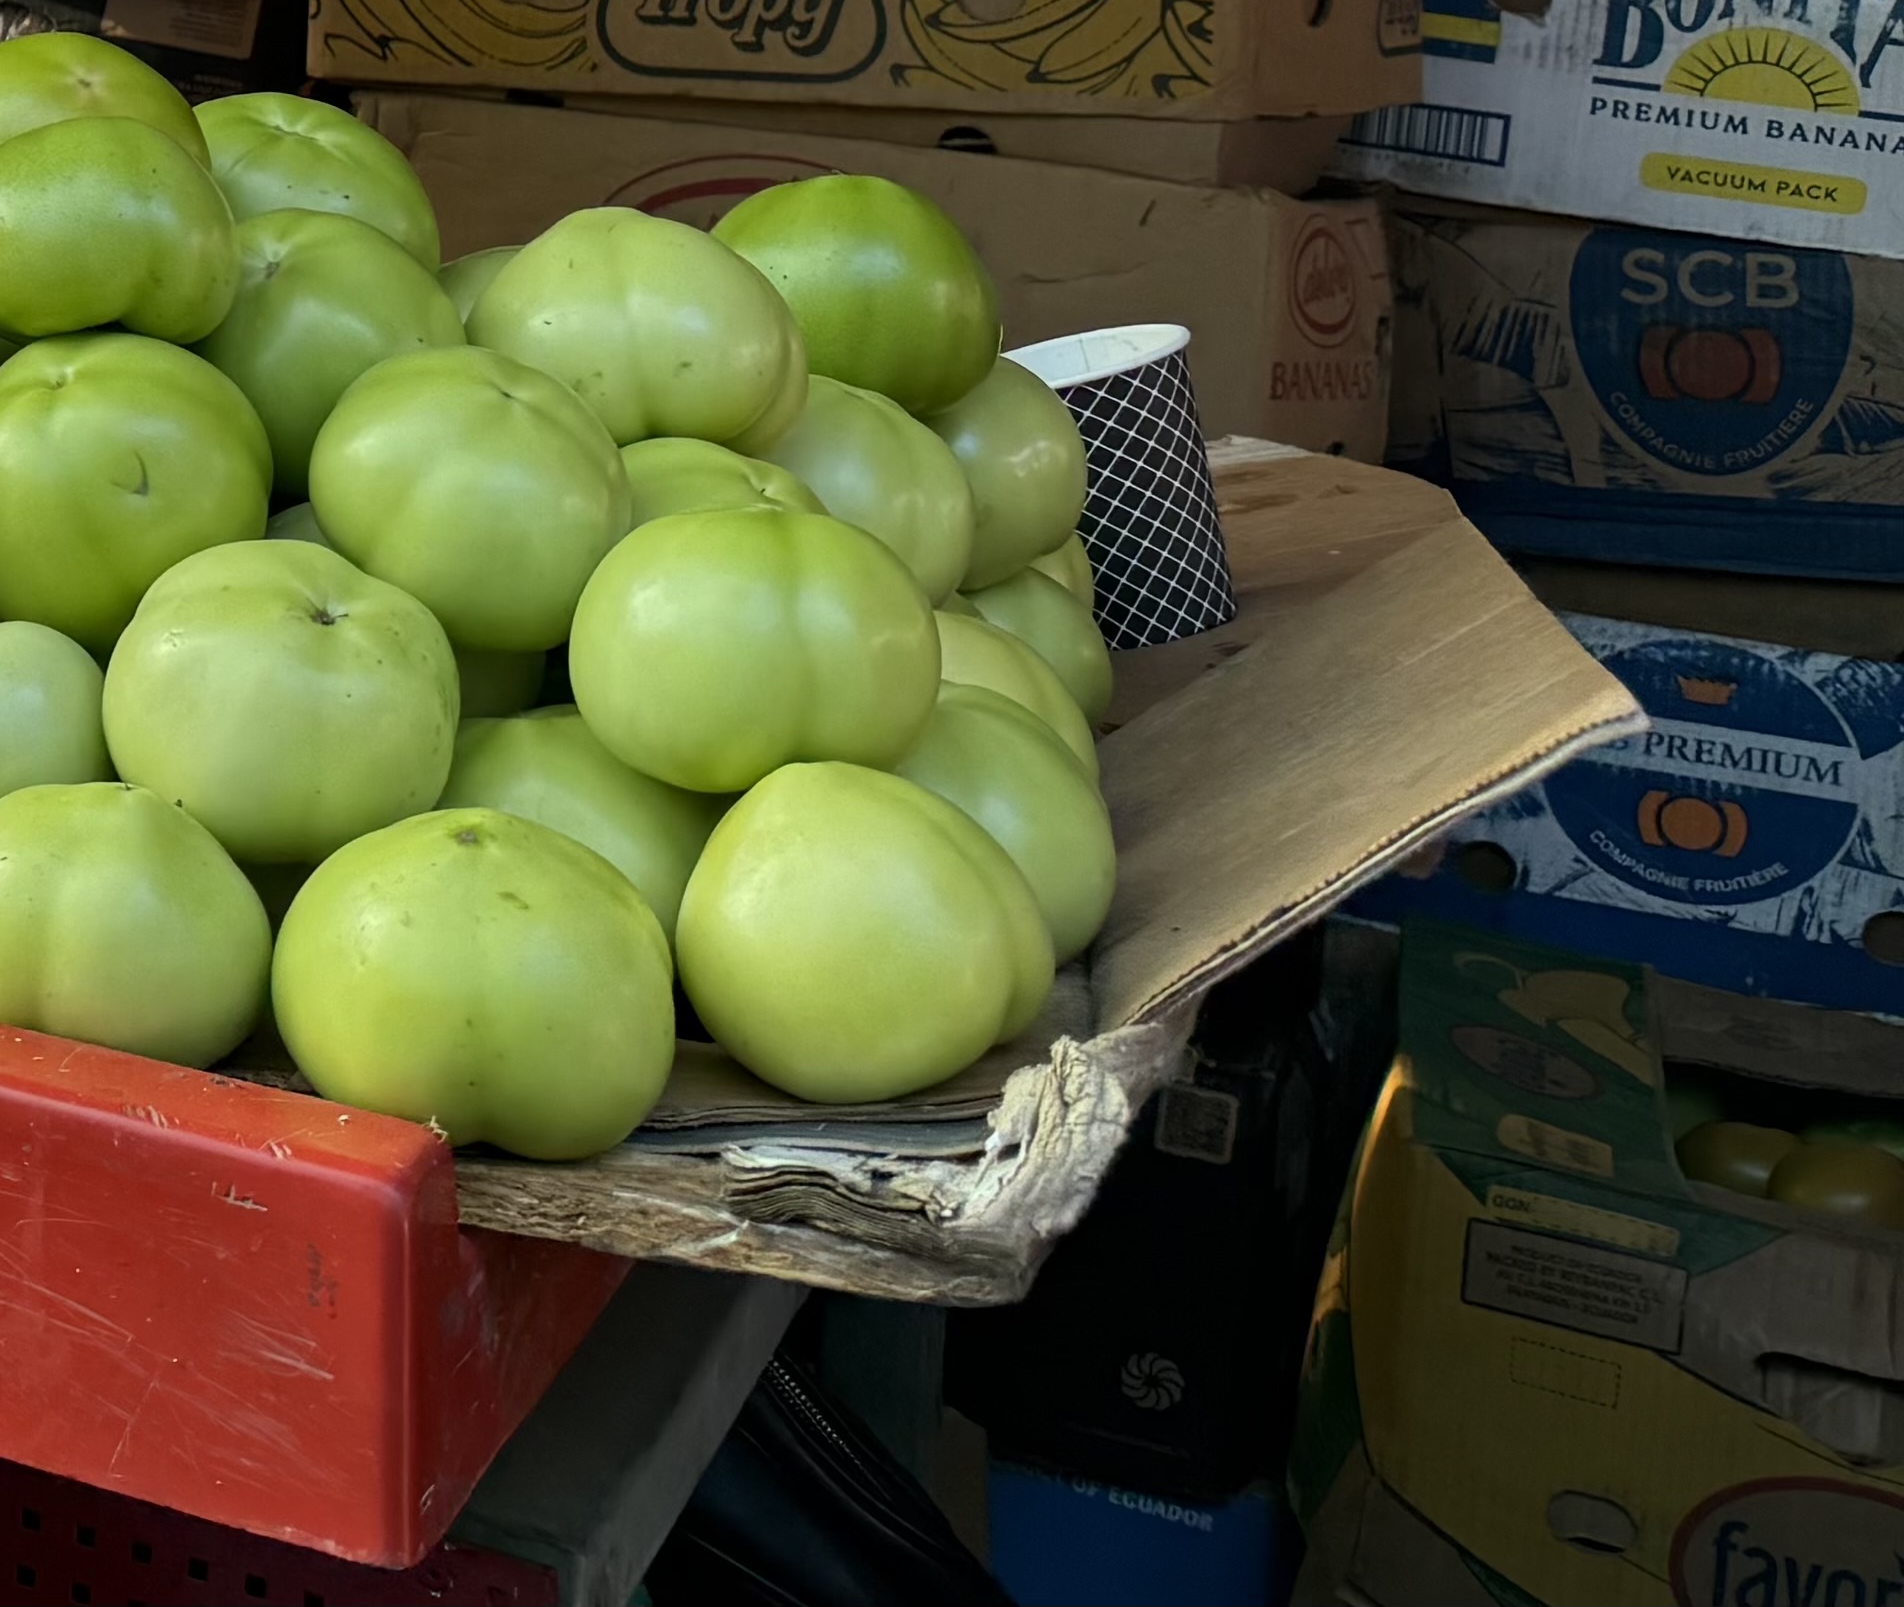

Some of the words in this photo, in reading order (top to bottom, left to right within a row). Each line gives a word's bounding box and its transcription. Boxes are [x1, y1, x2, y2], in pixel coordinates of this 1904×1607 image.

[1590, 96, 1749, 135] PREMIUM
[1666, 165, 1767, 194] VACUUM
[1775, 178, 1839, 204] PACK
[1619, 246, 1801, 309] SCB
[1609, 390, 1718, 470] COMPAGNIE
[1641, 730, 1845, 787] PREMIUM
[1588, 828, 1691, 892] COMPAGNIE
[1107, 1486, 1215, 1533] ECUADOR
